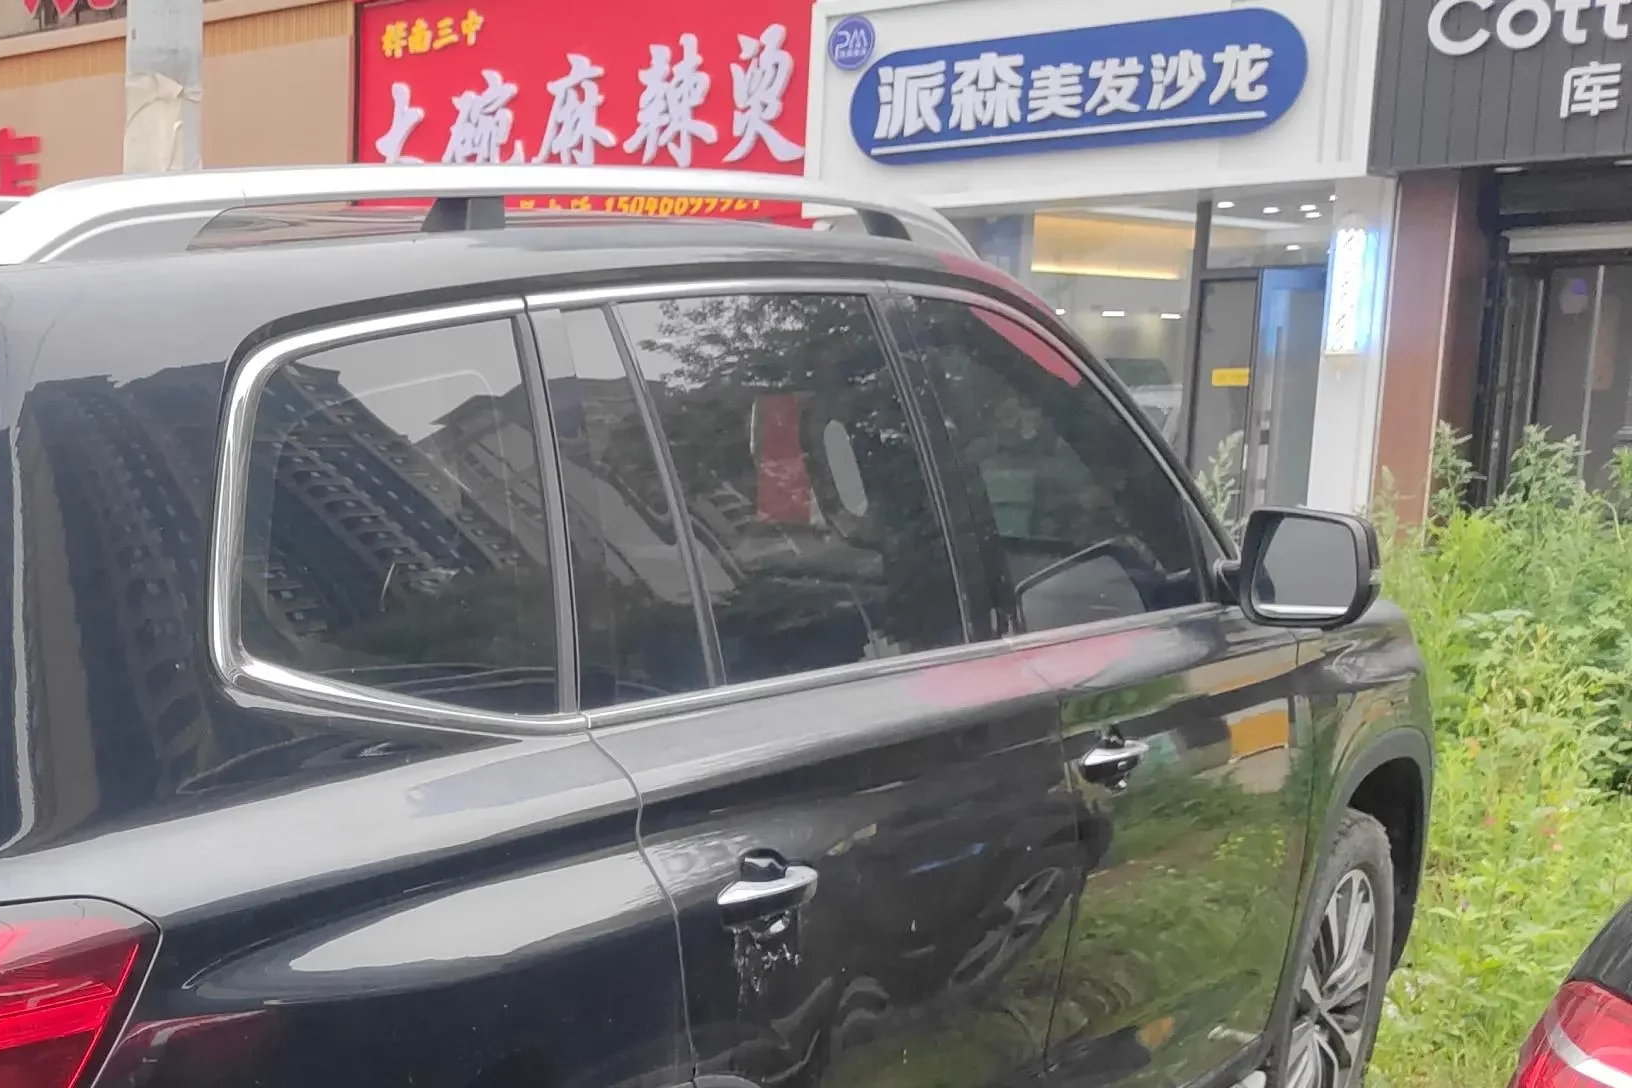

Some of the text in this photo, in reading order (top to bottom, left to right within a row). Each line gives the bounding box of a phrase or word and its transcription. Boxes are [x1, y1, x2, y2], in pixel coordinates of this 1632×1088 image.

[873, 43, 1274, 140] 派森美发沙龙
[1560, 61, 1622, 118] 库
